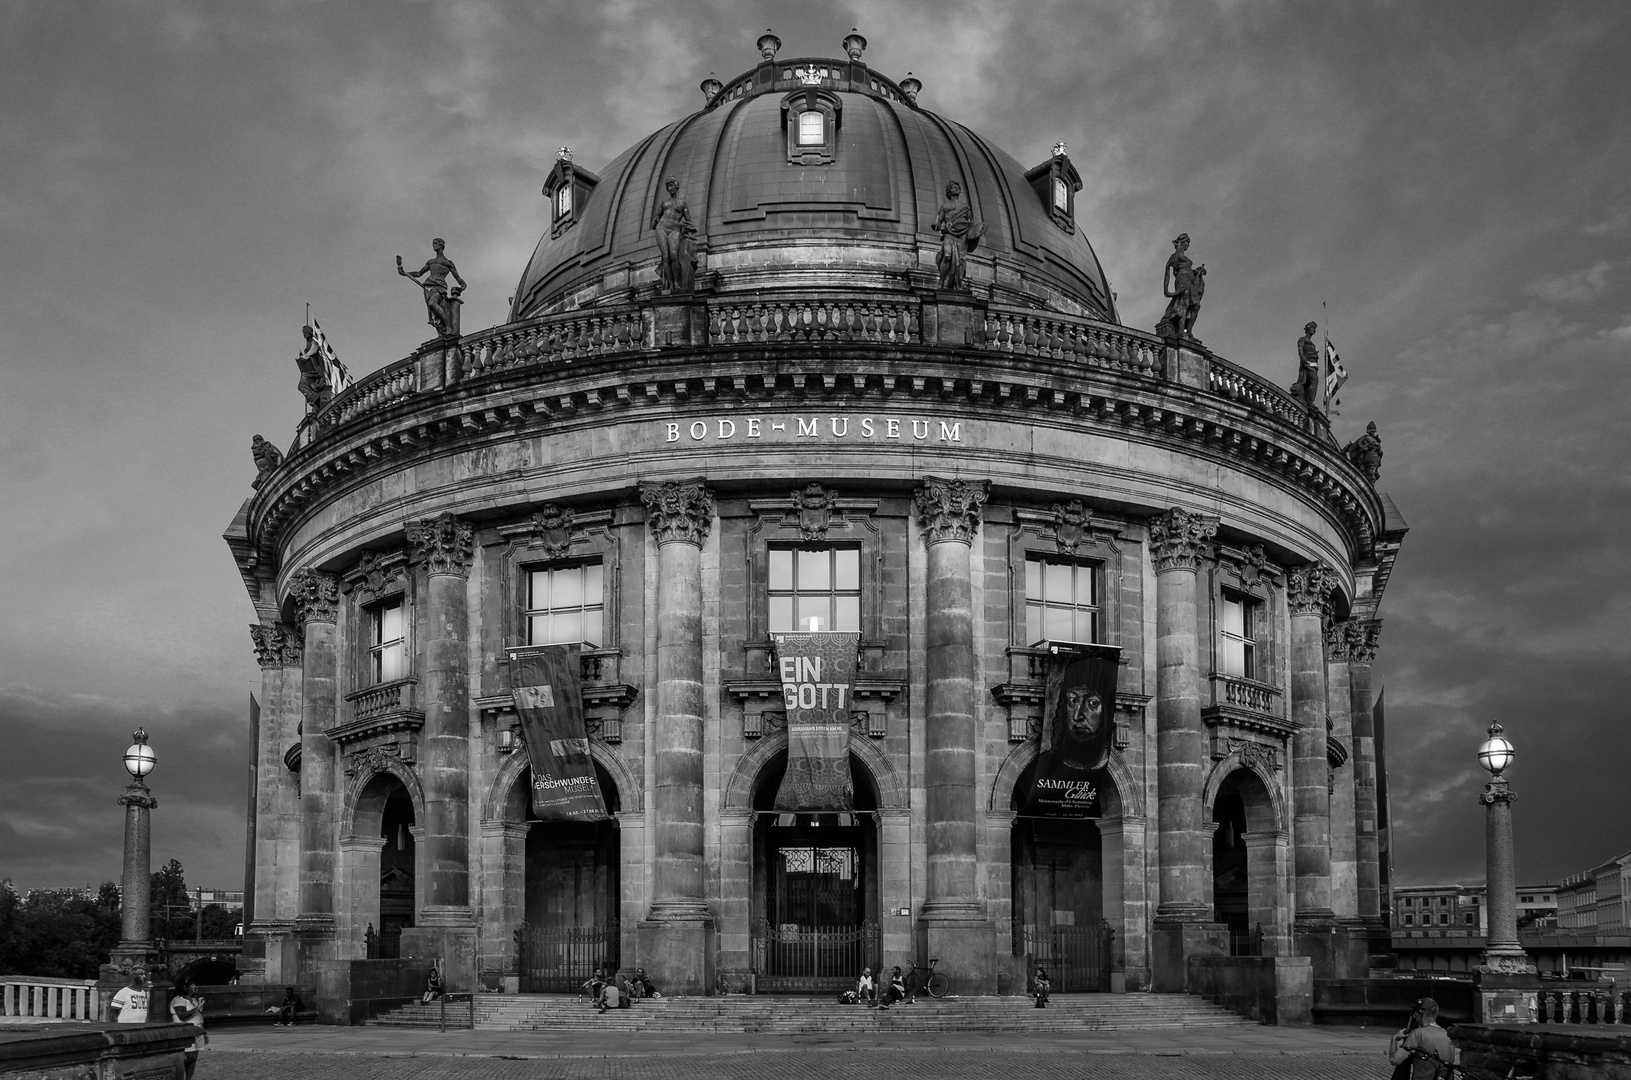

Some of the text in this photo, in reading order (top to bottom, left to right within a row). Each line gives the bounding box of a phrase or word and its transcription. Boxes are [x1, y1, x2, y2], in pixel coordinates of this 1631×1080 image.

[666, 417, 962, 443] BODE-MUSEUM
[780, 656, 821, 683] EIN
[783, 683, 849, 709] GOTT
[1037, 778, 1090, 790] SAMMLER
[1064, 787, 1097, 800] Glück
